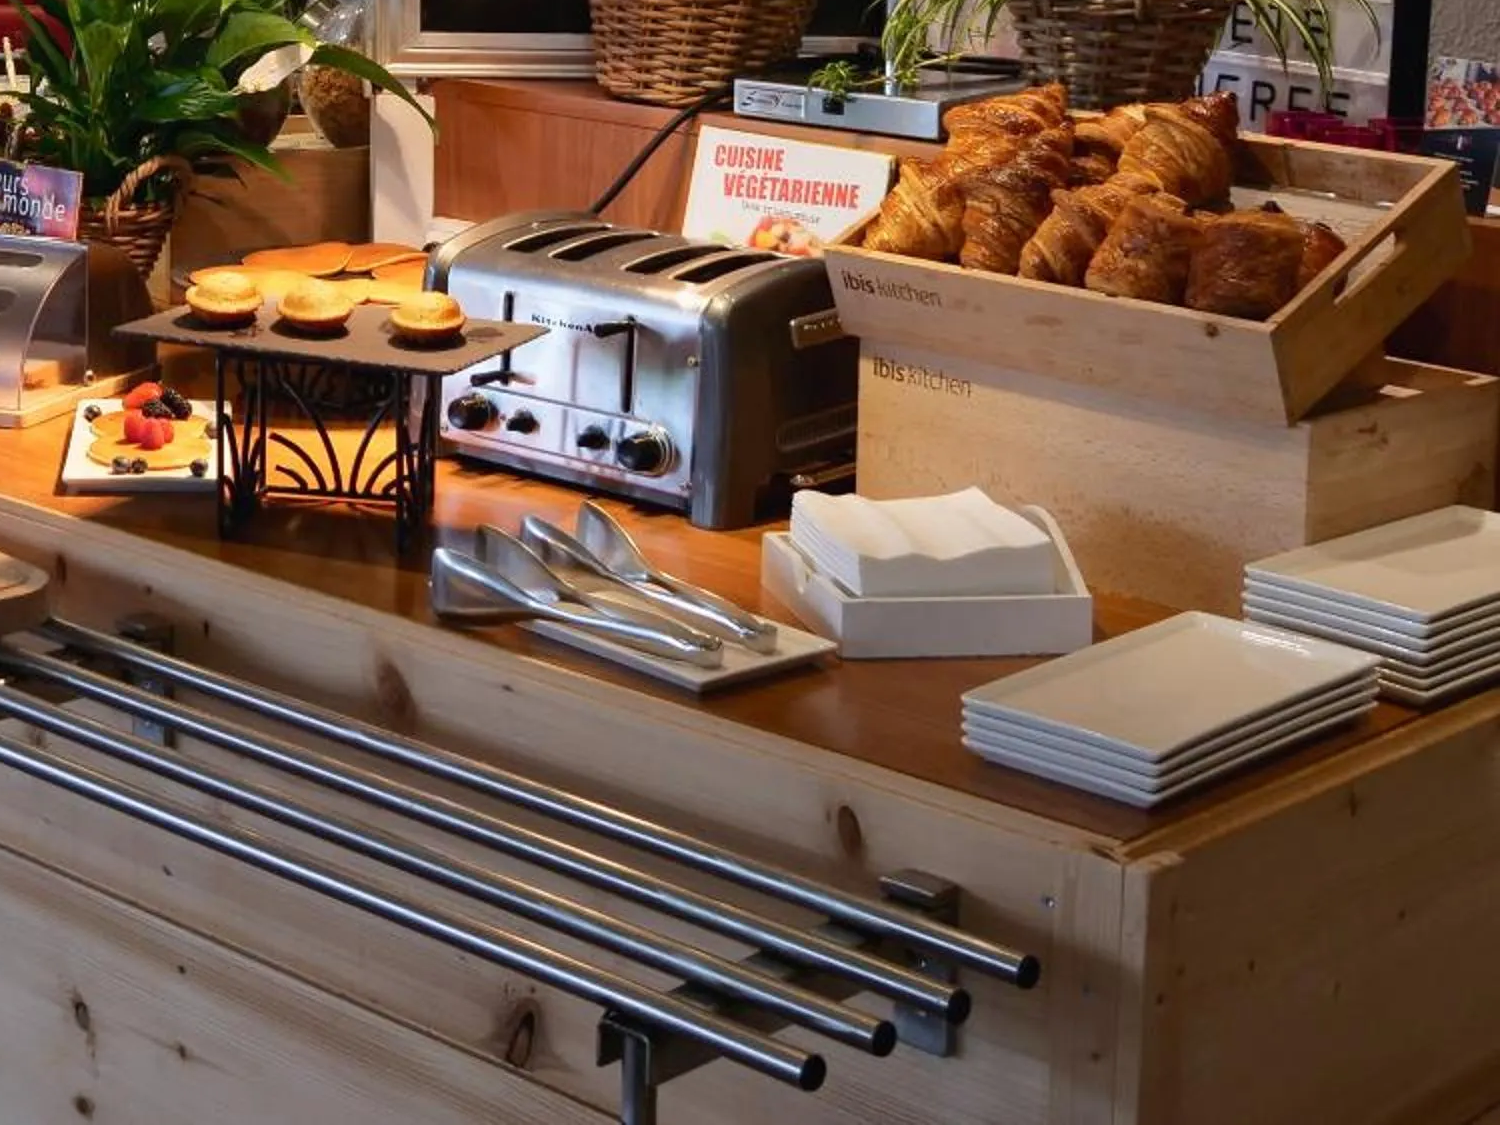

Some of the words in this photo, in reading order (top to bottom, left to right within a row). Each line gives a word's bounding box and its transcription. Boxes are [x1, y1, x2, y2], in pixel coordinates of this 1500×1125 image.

[714, 143, 785, 172] CUISINE
[2, 191, 66, 222] monde
[723, 169, 861, 210] VÉGÉTARIENNE
[841, 269, 875, 294] ibis
[876, 275, 942, 307] kitchen
[531, 313, 593, 333] KitchenA
[873, 356, 905, 382] ibis
[907, 364, 972, 398] kitchen
